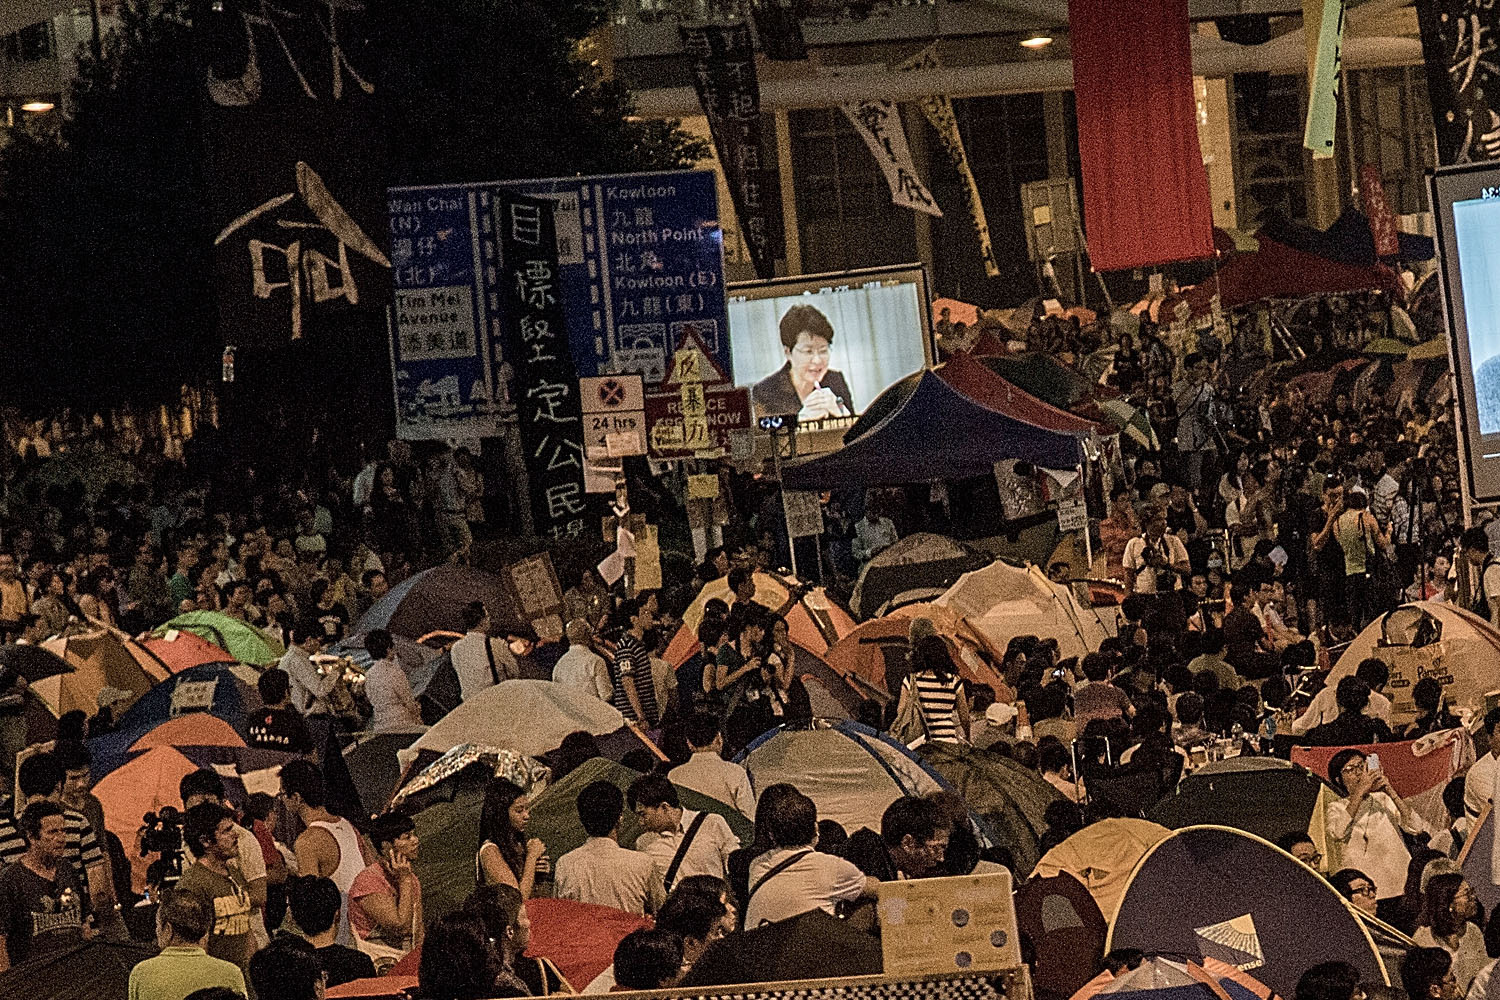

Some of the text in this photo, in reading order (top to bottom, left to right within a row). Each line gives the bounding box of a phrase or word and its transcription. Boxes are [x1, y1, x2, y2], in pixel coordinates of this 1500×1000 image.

[606, 184, 676, 200] Kowloon
[427, 196, 464, 212] Chai
[390, 215, 421, 233] (N)
[611, 229, 658, 245] North
[662, 226, 704, 242] Point
[614, 270, 717, 290] Kowloon (E)
[397, 293, 461, 309] Tim Mei
[399, 312, 459, 325] Avenue
[667, 398, 727, 415] RECE
[592, 416, 637, 430] 24 hrs
[707, 411, 742, 426] NOW
